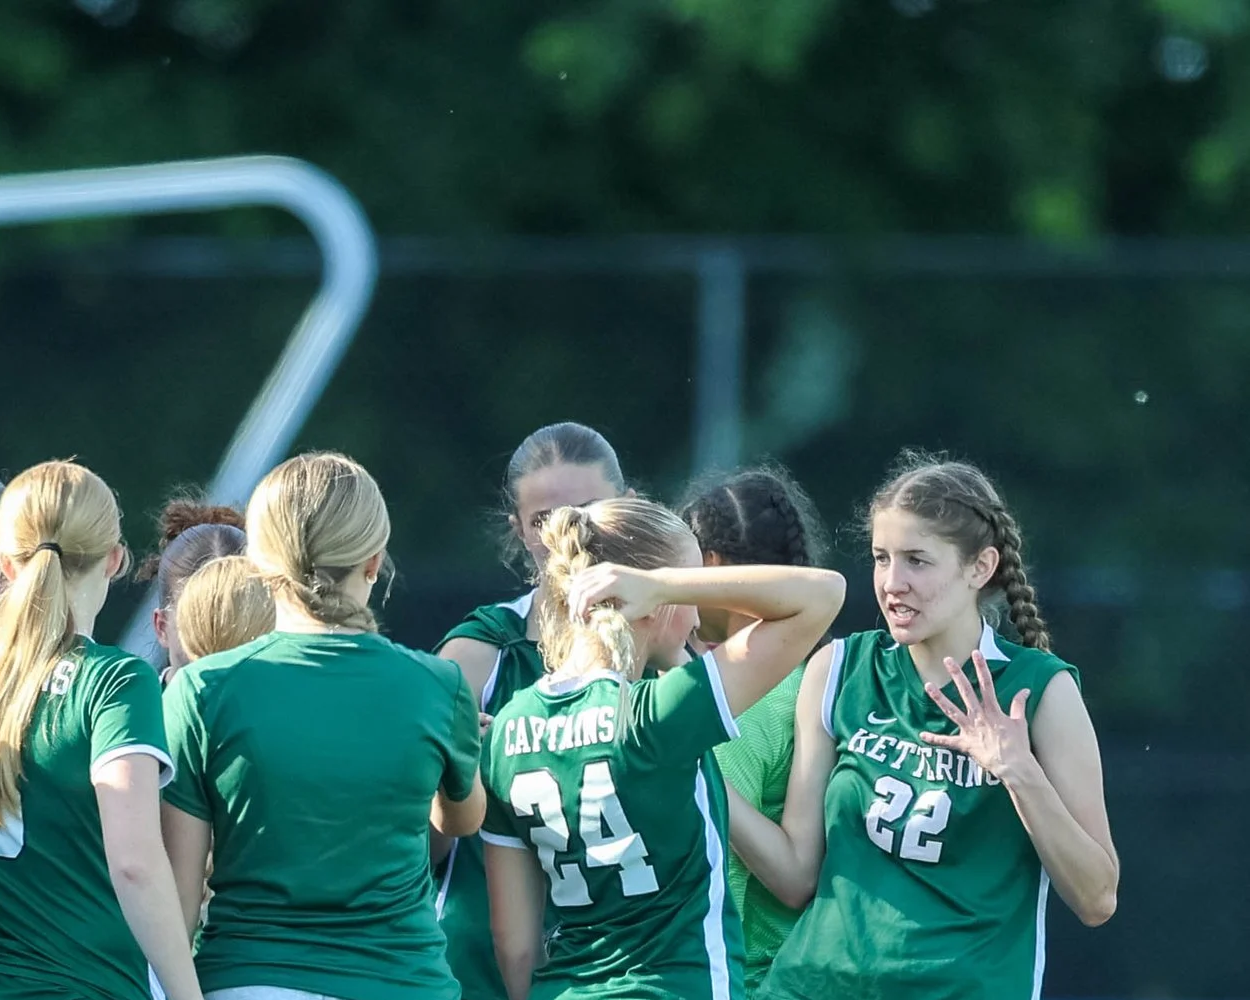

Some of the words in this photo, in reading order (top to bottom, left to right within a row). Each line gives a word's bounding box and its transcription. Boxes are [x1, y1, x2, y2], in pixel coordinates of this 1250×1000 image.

[505, 706, 615, 757] CAPTAINS
[848, 728, 1000, 789] KETTRIN
[510, 760, 660, 907] 24
[866, 775, 952, 863] 22
